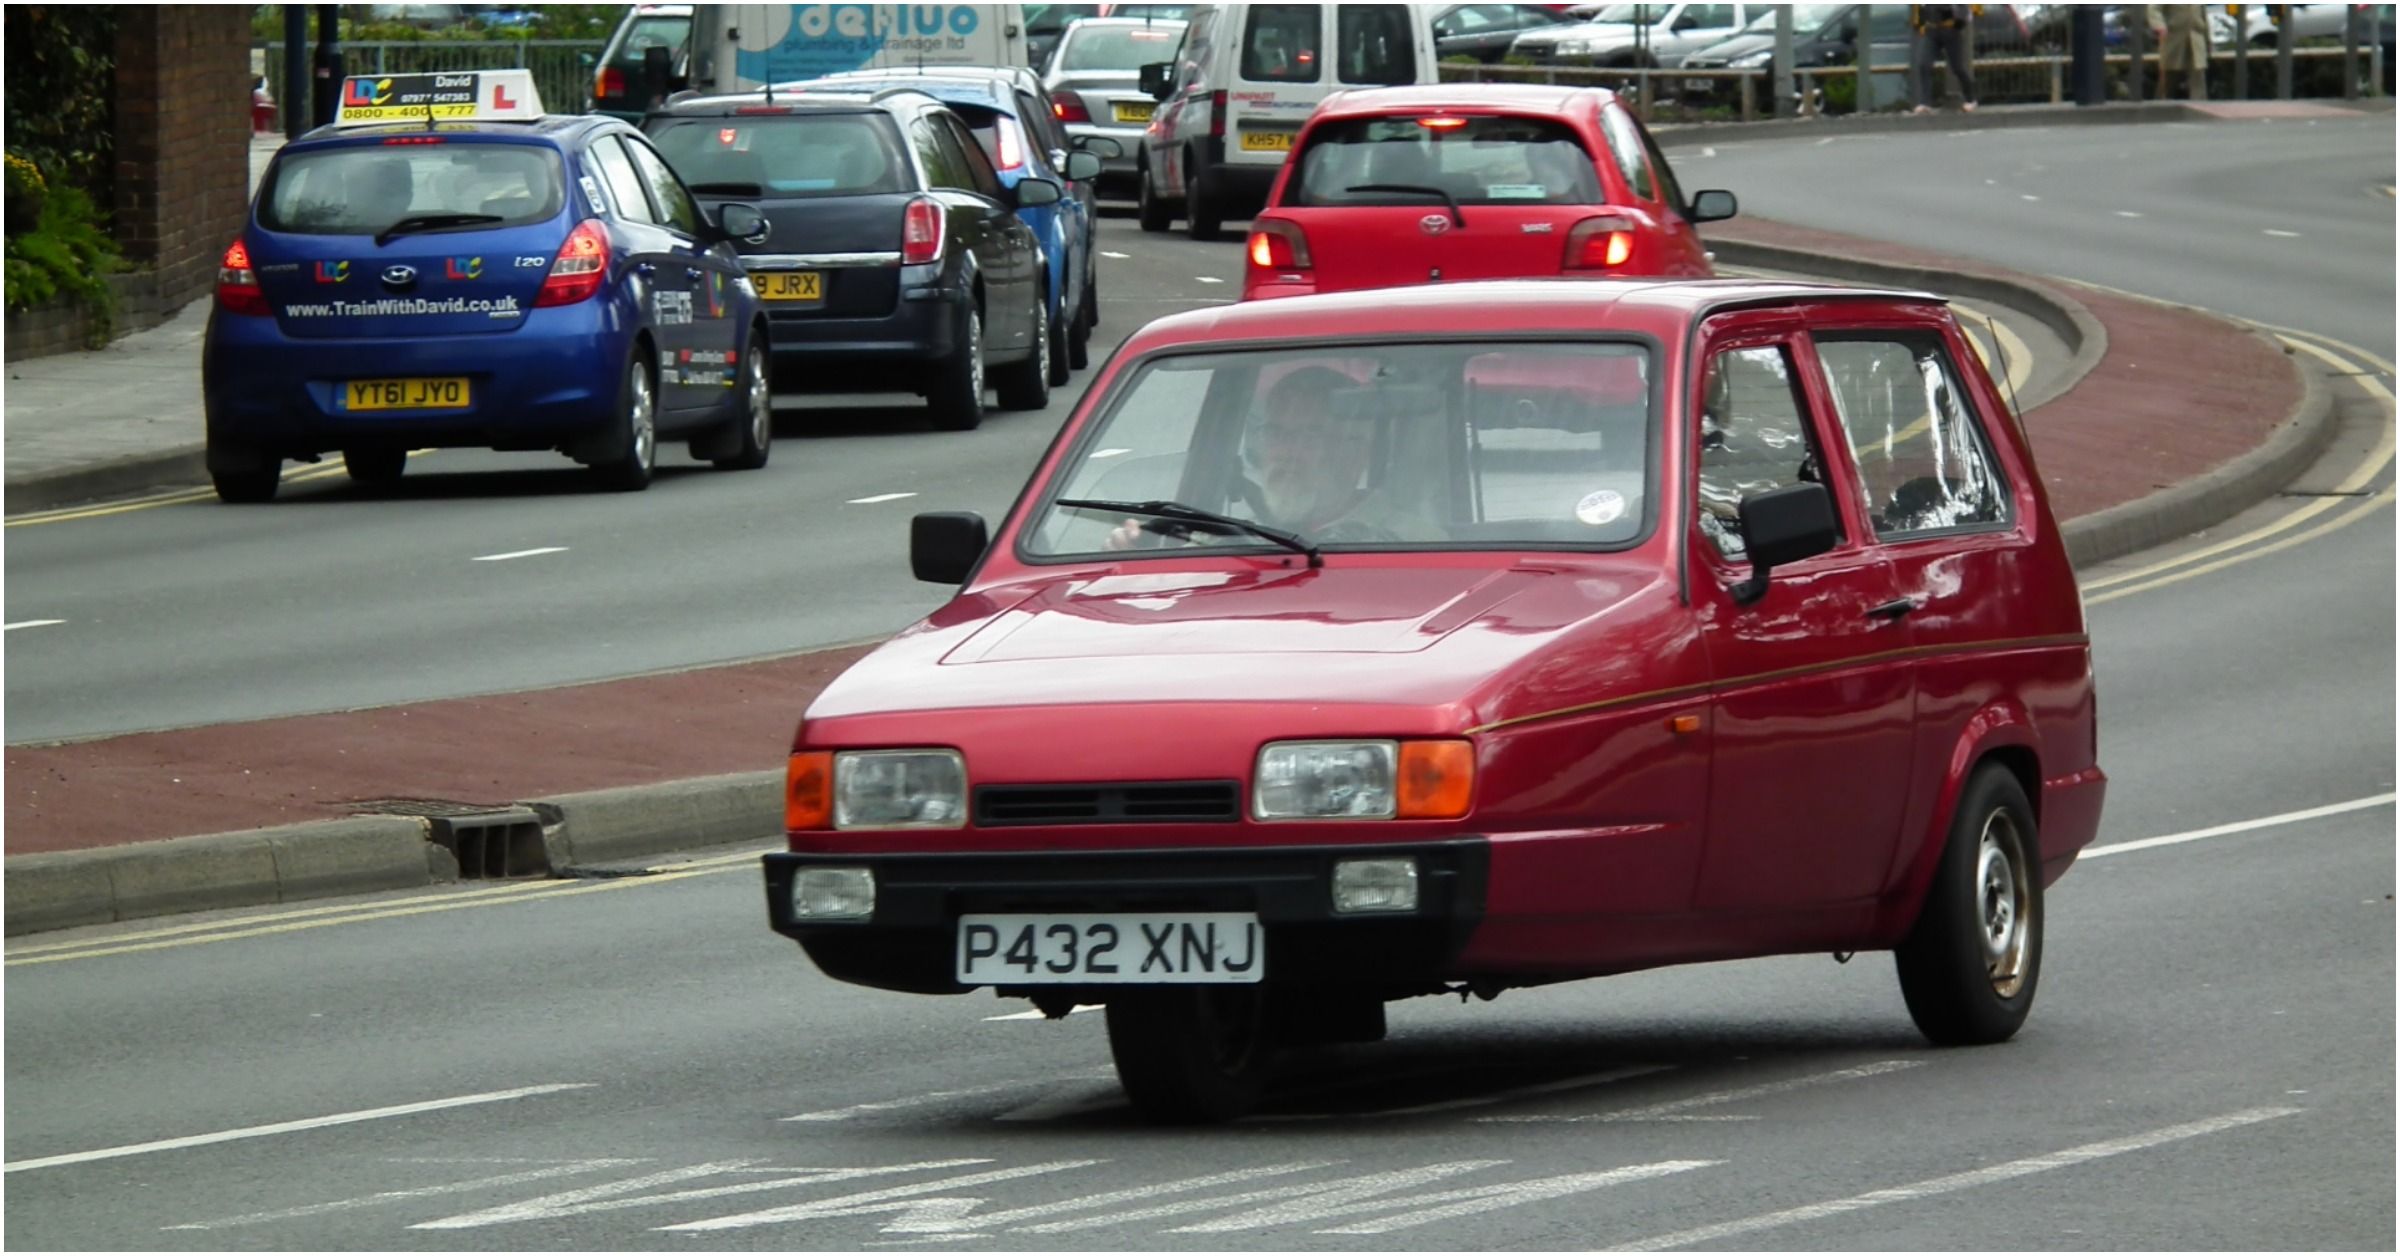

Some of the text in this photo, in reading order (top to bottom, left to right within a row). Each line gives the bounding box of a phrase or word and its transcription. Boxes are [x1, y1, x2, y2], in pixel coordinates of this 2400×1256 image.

[873, 36, 942, 52] rainage
[947, 36, 964, 49] ltd
[344, 78, 392, 106] LDC
[435, 75, 471, 87] David
[494, 85, 516, 109] L
[343, 108, 382, 119] 0800
[400, 106, 429, 117] 400
[448, 105, 476, 115] 777
[774, 275, 816, 295] JRX
[286, 295, 518, 317] www.TrainWithDavid.co.uk
[354, 382, 406, 405] YT61
[963, 922, 1256, 974] P432 XNJ
